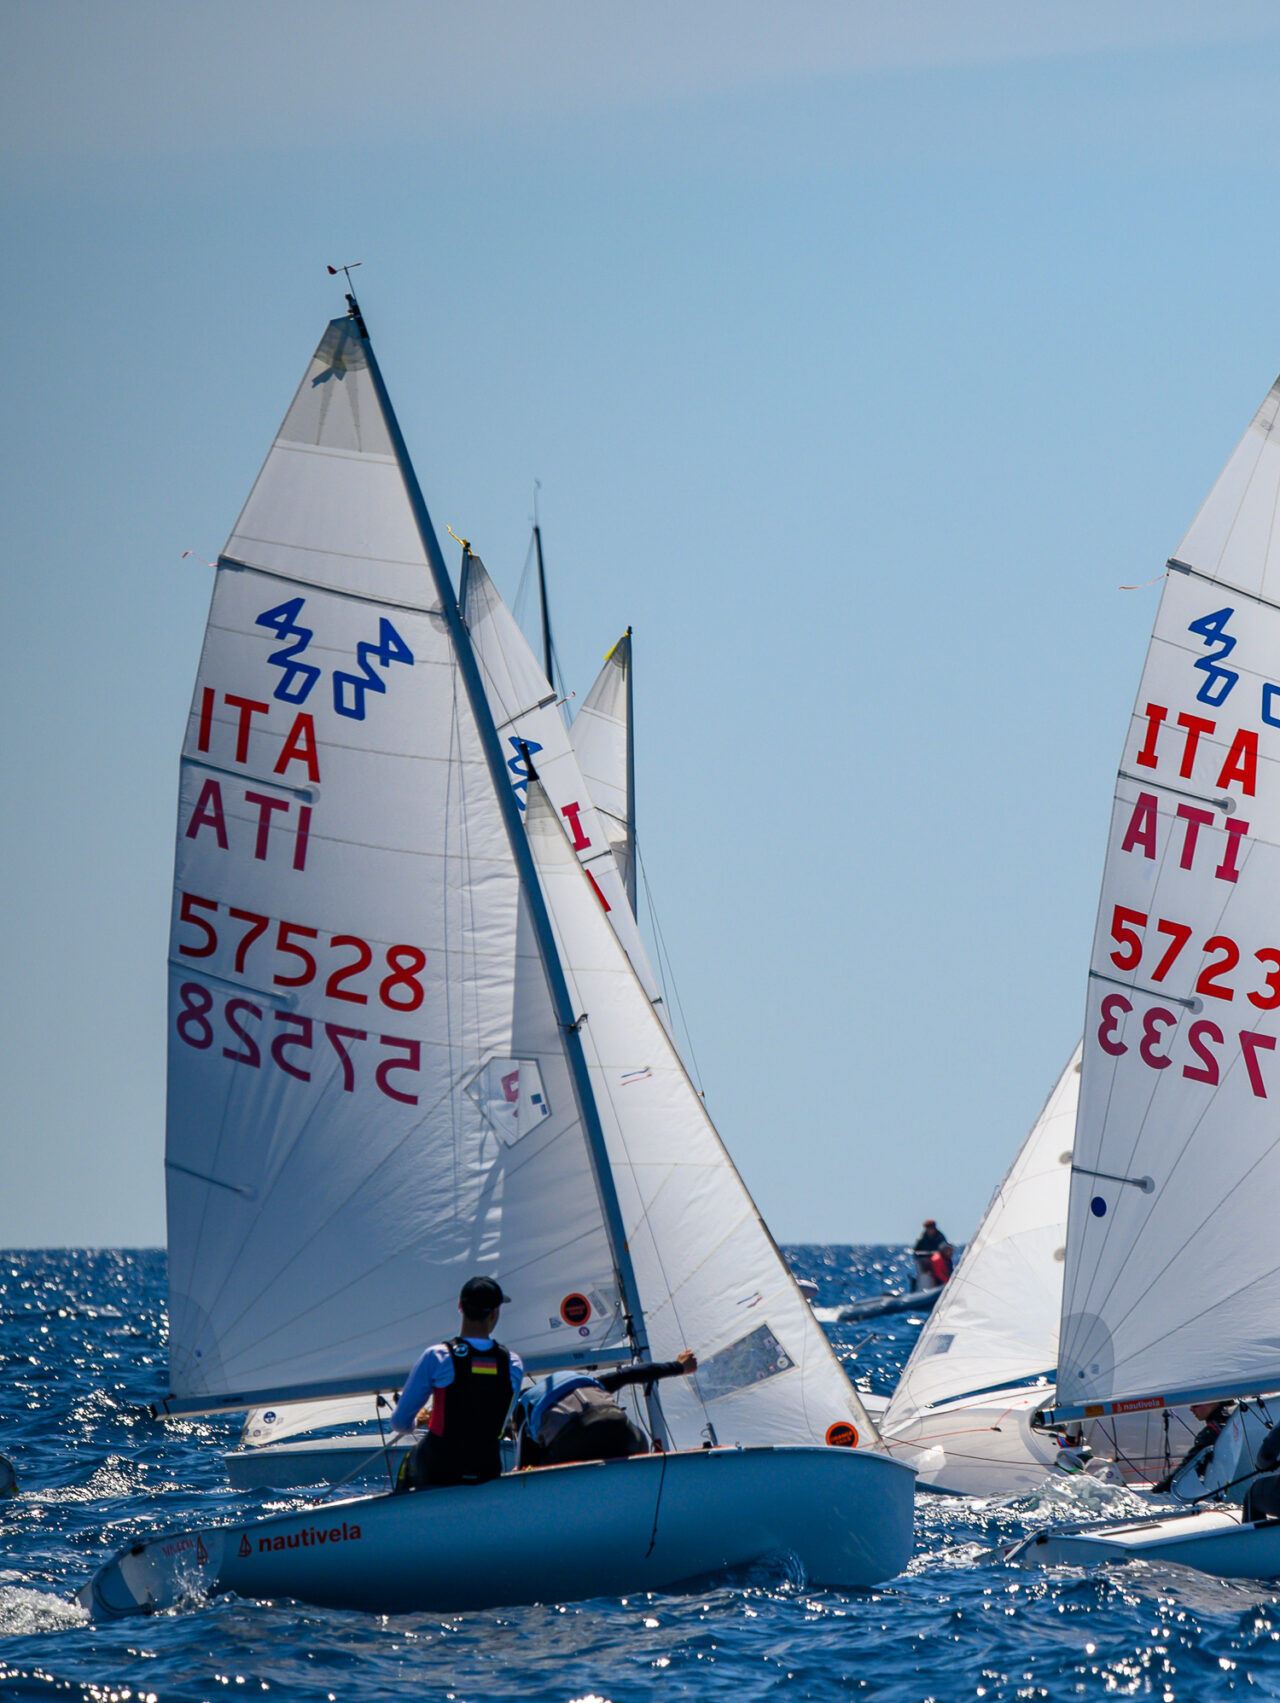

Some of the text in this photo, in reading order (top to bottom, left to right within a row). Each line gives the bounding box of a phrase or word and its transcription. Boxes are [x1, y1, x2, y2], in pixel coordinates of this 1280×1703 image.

[255, 597, 321, 704] 420
[1189, 607, 1239, 707] 420
[197, 687, 321, 783] ITA
[1136, 702, 1259, 798] ITA
[178, 892, 427, 1012] 57528
[258, 1522, 361, 1553] nautivela
